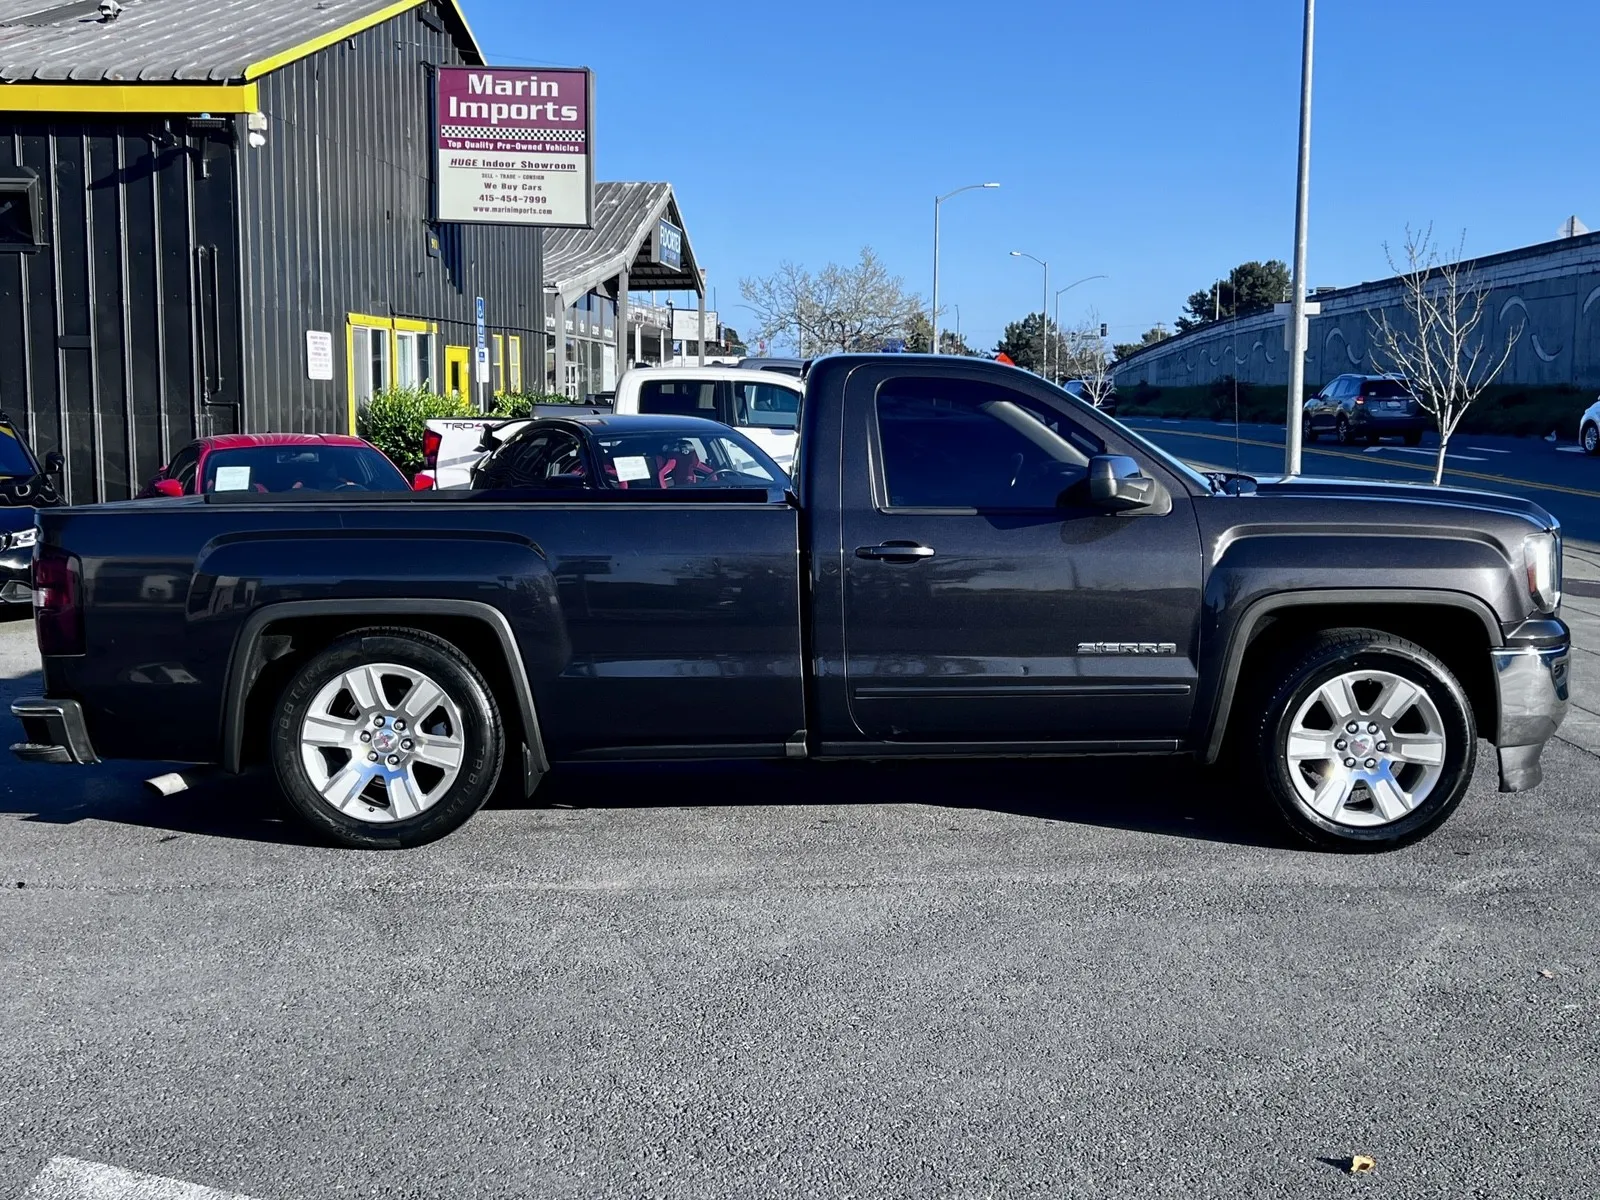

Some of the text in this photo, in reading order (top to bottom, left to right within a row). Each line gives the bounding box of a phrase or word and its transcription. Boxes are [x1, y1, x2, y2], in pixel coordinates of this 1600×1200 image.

[468, 73, 559, 97] Marin
[449, 96, 578, 125] Imports
[447, 140, 579, 152] Top Quality Pre-Owned Vehicles
[450, 158, 576, 170] HUGE Indoor Showroom
[484, 182, 542, 191] We Buy Cars
[478, 194, 547, 204] 415-454-7999
[472, 206, 553, 215] www.marinimports.com
[1077, 641, 1177, 654] SIERRA
